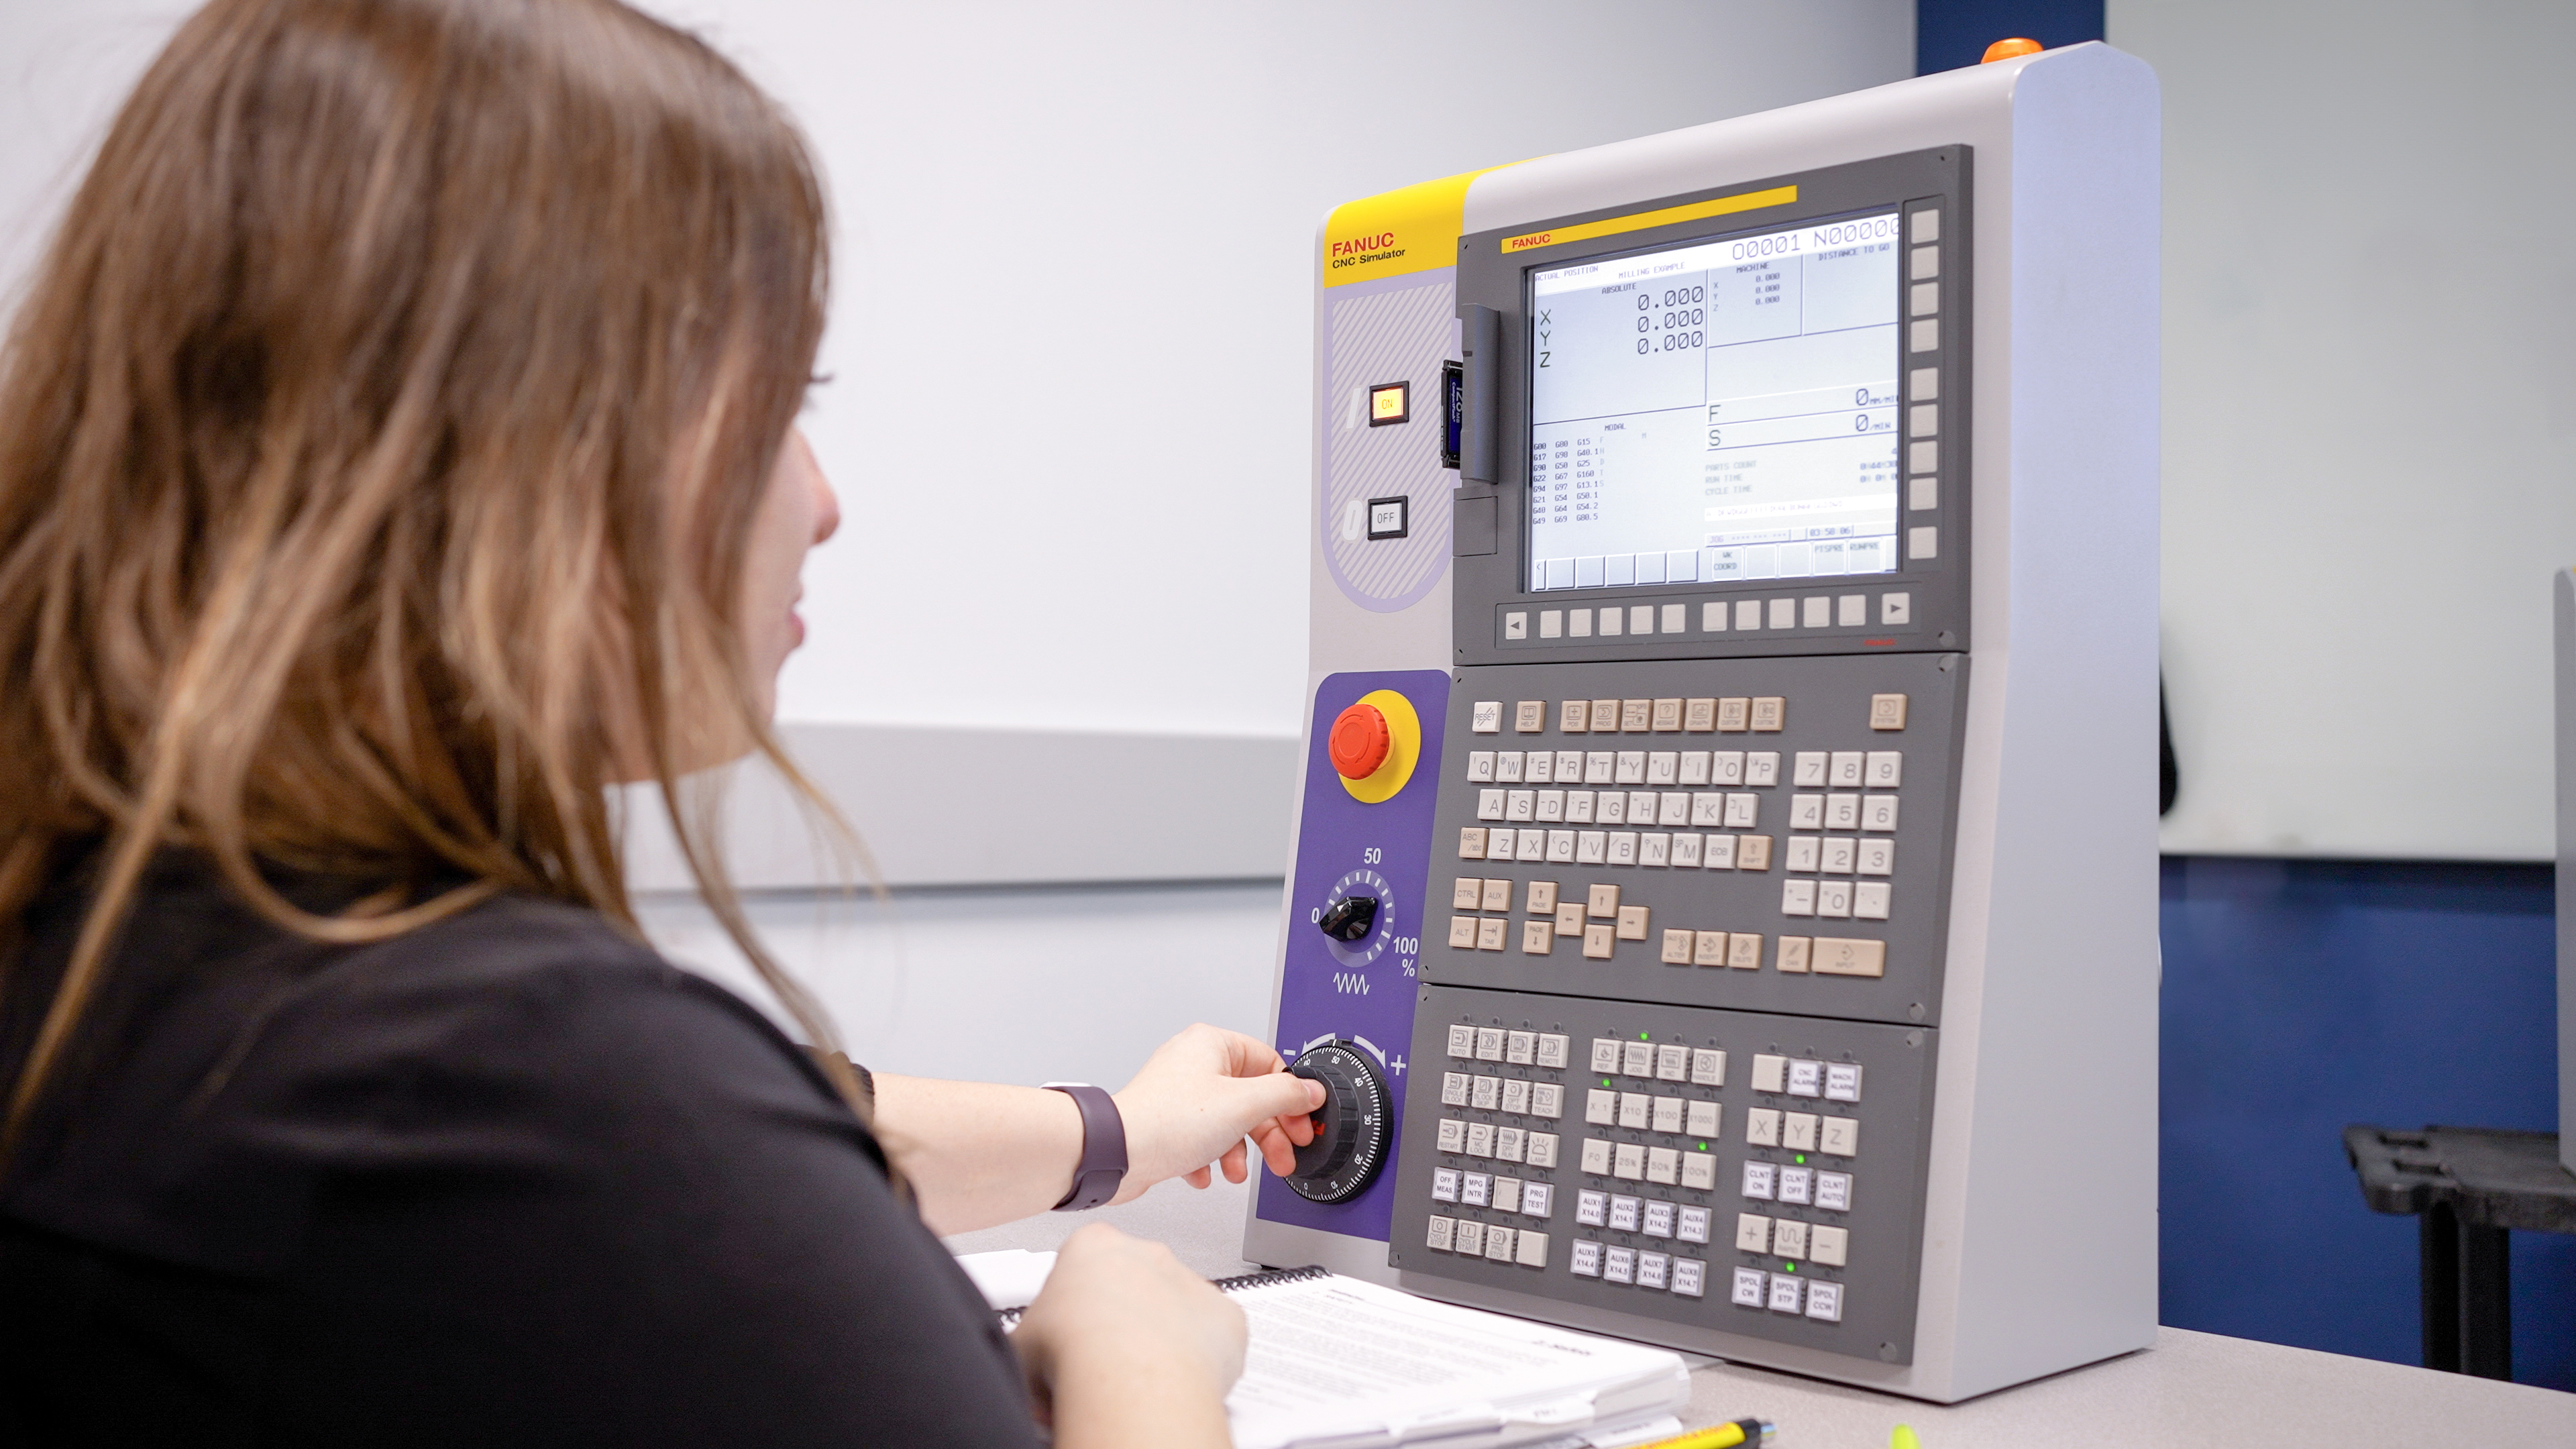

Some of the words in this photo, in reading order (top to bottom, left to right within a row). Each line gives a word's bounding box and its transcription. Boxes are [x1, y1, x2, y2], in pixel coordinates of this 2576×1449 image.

[1332, 233, 1394, 257] FANUC
[1512, 234, 1551, 249] FANUC
[1819, 248, 1858, 261] DISTANCE
[1865, 246, 1874, 254] TO
[1879, 243, 1889, 252] GO
[1332, 258, 1356, 268] CNC
[1360, 250, 1405, 264] Simulator
[1536, 272, 1560, 281] ACTUAL
[1564, 266, 1598, 276] POSITION
[1619, 268, 1650, 278] MILLING
[1654, 262, 1685, 272] EXAMPLE
[1736, 262, 1770, 274] MACHINE
[1756, 272, 1780, 282] 0.000
[1602, 283, 1636, 294] ABSOLUTE
[1756, 284, 1780, 294] 0.000
[1540, 309, 1551, 325] X
[1638, 286, 1703, 311] 0.000
[1756, 295, 1780, 305] 0.000
[1540, 331, 1551, 345] Y
[1638, 309, 1703, 332] 0.000
[1540, 352, 1551, 368] Z
[1638, 331, 1703, 354] 0.000
[1382, 398, 1393, 409] ON
[1709, 405, 1721, 422] F
[1856, 388, 1868, 406] 0
[1709, 429, 1721, 446] S
[1856, 414, 1868, 431] 0
[1556, 440, 1568, 448] G80
[1577, 448, 1598, 456] G40.1
[1576, 492, 1598, 500] G50.1
[1378, 513, 1394, 523] OFF
[1576, 513, 1598, 521] G80.5
[1480, 761, 1489, 775] Q
[1508, 761, 1518, 775] W
[1538, 761, 1547, 774] E
[1567, 761, 1576, 775] R
[1599, 762, 1609, 775] T
[1629, 761, 1639, 775] Y
[1661, 763, 1670, 776] U
[1697, 762, 1700, 776] I
[1726, 763, 1737, 777] O
[1760, 763, 1771, 777] P
[1808, 763, 1820, 778] 7
[1844, 763, 1856, 778] 8
[1880, 763, 1892, 778] 9
[1489, 799, 1499, 812] A
[1518, 800, 1528, 813] S
[1548, 801, 1558, 814] D
[1578, 802, 1588, 814] F
[1609, 802, 1619, 816] G
[1640, 803, 1651, 817] H
[1673, 804, 1683, 817] J
[1705, 804, 1715, 818] K
[1739, 806, 1748, 820] L
[1805, 807, 1815, 821] 4
[1839, 806, 1851, 821] 5
[1876, 808, 1889, 822] 6
[1462, 833, 1477, 841] ABC
[1500, 839, 1509, 852] Z
[1528, 840, 1538, 853] X
[1559, 841, 1569, 855] C
[1591, 842, 1600, 855] V
[1620, 843, 1630, 857] B
[1652, 845, 1663, 858] N
[1684, 845, 1695, 859] M
[1364, 848, 1381, 864] 50
[1802, 849, 1809, 863] 1
[1835, 851, 1847, 865] 2
[1872, 851, 1884, 867] 3
[1457, 890, 1475, 898] CTRL
[1311, 908, 1320, 923] 0
[1393, 936, 1417, 955] 100
[1402, 959, 1415, 977] %
[1624, 1107, 1641, 1116] X10
[1654, 1110, 1677, 1120] X100
[1756, 1120, 1767, 1136] X
[1793, 1124, 1805, 1140] Y
[1830, 1129, 1841, 1144] Z
[1619, 1158, 1636, 1167] 25%
[1651, 1162, 1670, 1171] 50%
[1469, 1179, 1483, 1187] MPG
[1467, 1190, 1482, 1198] INTR
[1529, 1189, 1544, 1198] PRG
[1821, 1193, 1843, 1201] AUTO
[1527, 1199, 1544, 1209] TEST
[1583, 1197, 1601, 1206] AUX1
[1616, 1203, 1633, 1212] AUX2
[1582, 1209, 1600, 1218] X14.0
[1615, 1214, 1633, 1223] X14.1
[1650, 1208, 1668, 1218] AUX3
[1684, 1214, 1703, 1223] AUX4
[1649, 1220, 1667, 1228] X14.2
[1683, 1225, 1702, 1234] X14.3
[1577, 1248, 1595, 1257] AUX5
[1576, 1259, 1594, 1267] X14.4
